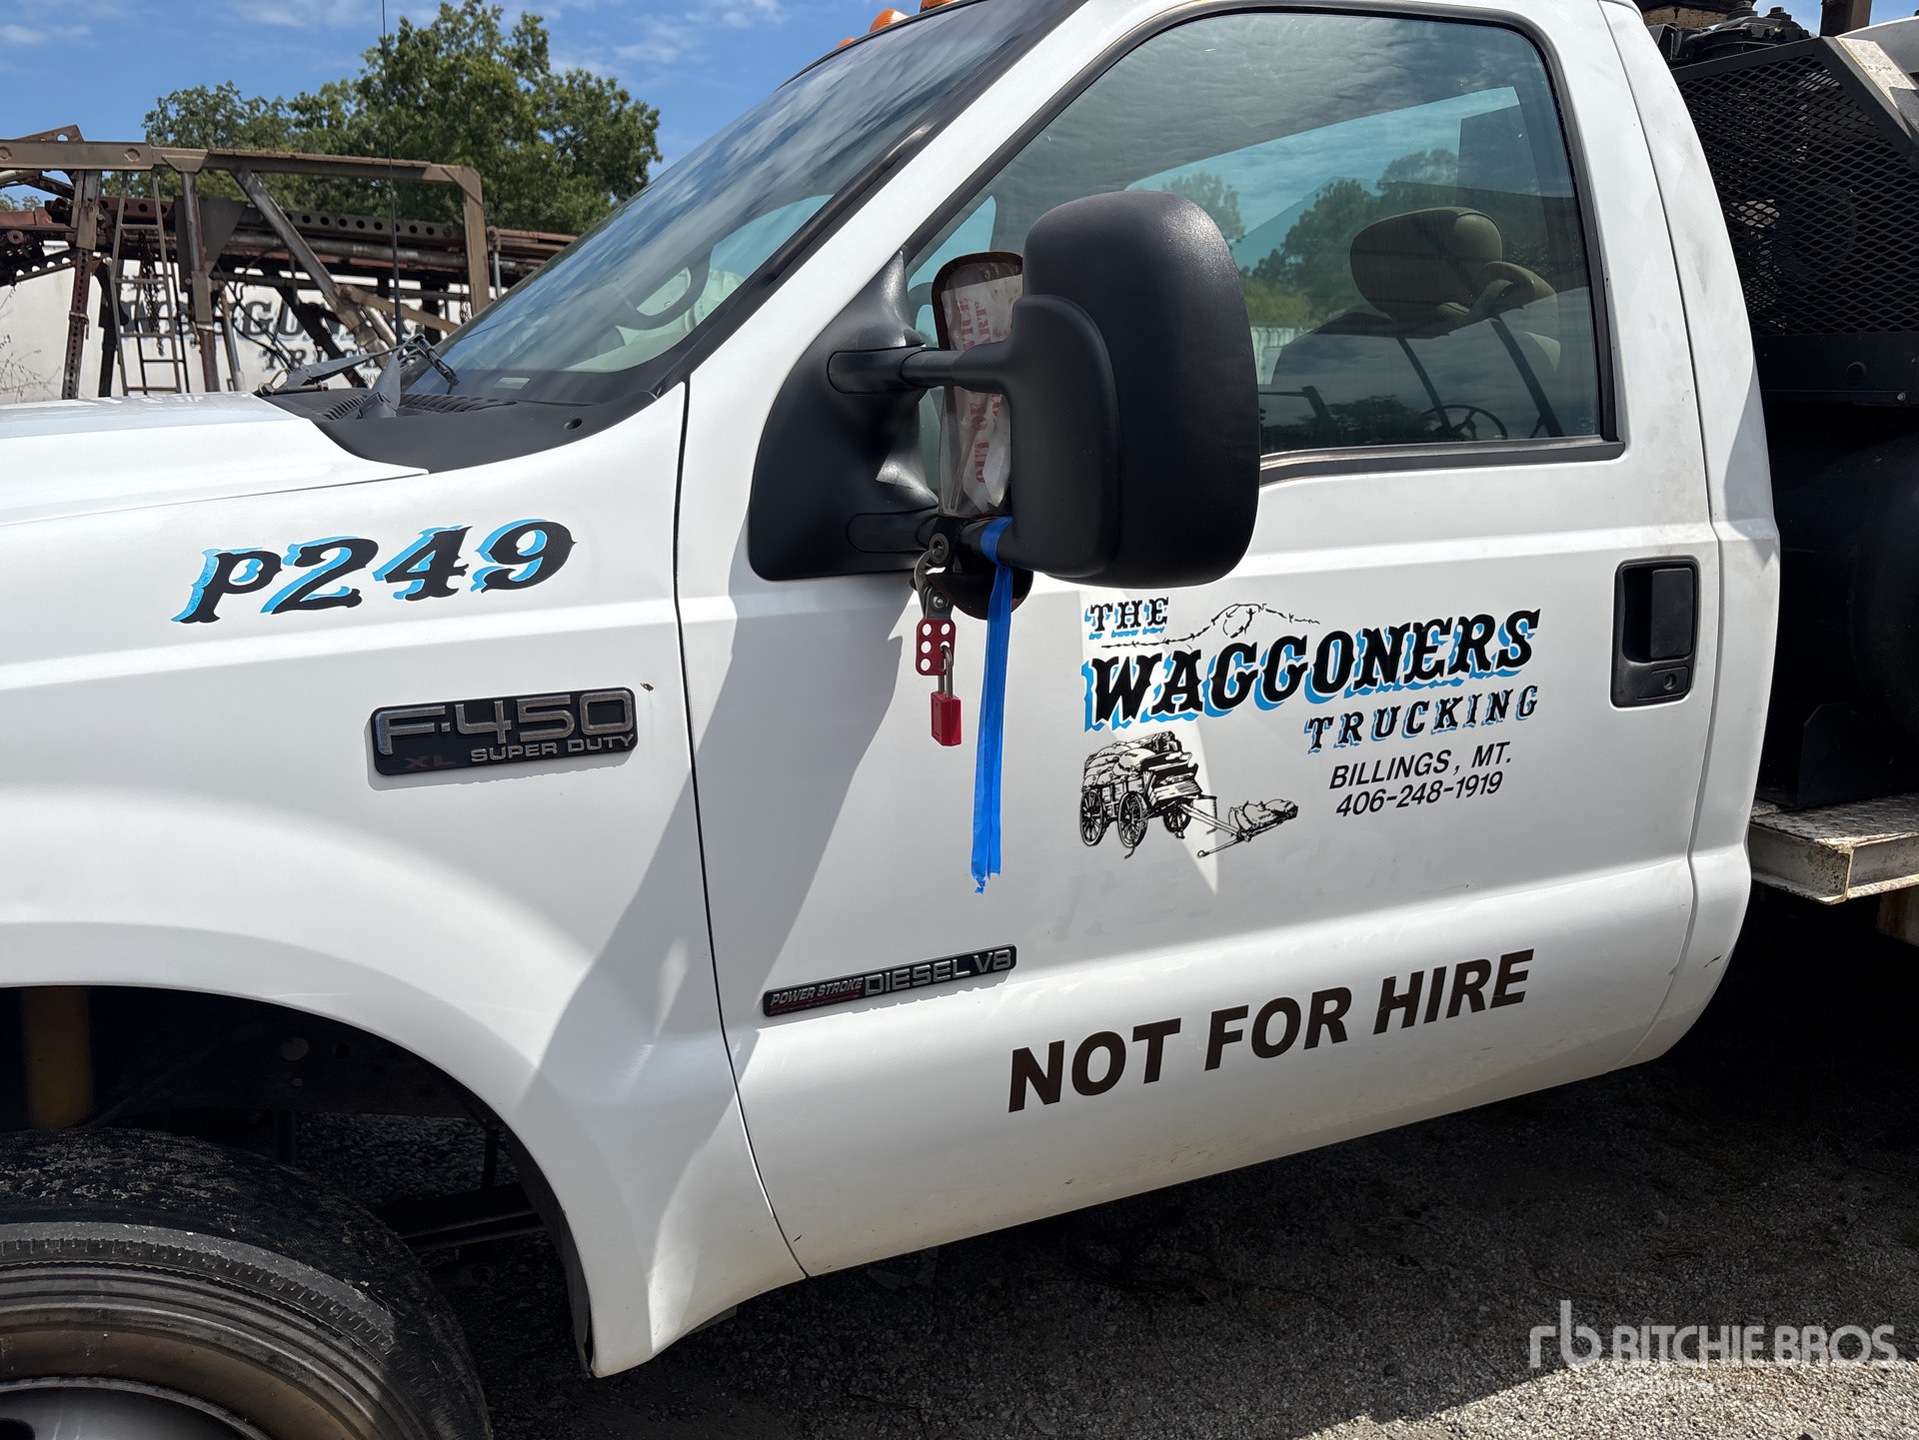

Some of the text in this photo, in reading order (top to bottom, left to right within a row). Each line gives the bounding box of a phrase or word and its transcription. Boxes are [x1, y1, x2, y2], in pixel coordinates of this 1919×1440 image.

[171, 519, 577, 624] P249
[1084, 597, 1169, 639] THE
[1081, 608, 1541, 732] WAGGONERS
[1304, 684, 1539, 754] TRUCKING
[404, 755, 456, 769] XL
[471, 734, 635, 763] SUPER DUTY
[1471, 742, 1512, 768] MT.
[1335, 772, 1503, 817] 406-248-1919
[770, 949, 1012, 1006] POWER STROKE DIESEL V8
[1008, 948, 1534, 1113] NOT FOR HIRE
